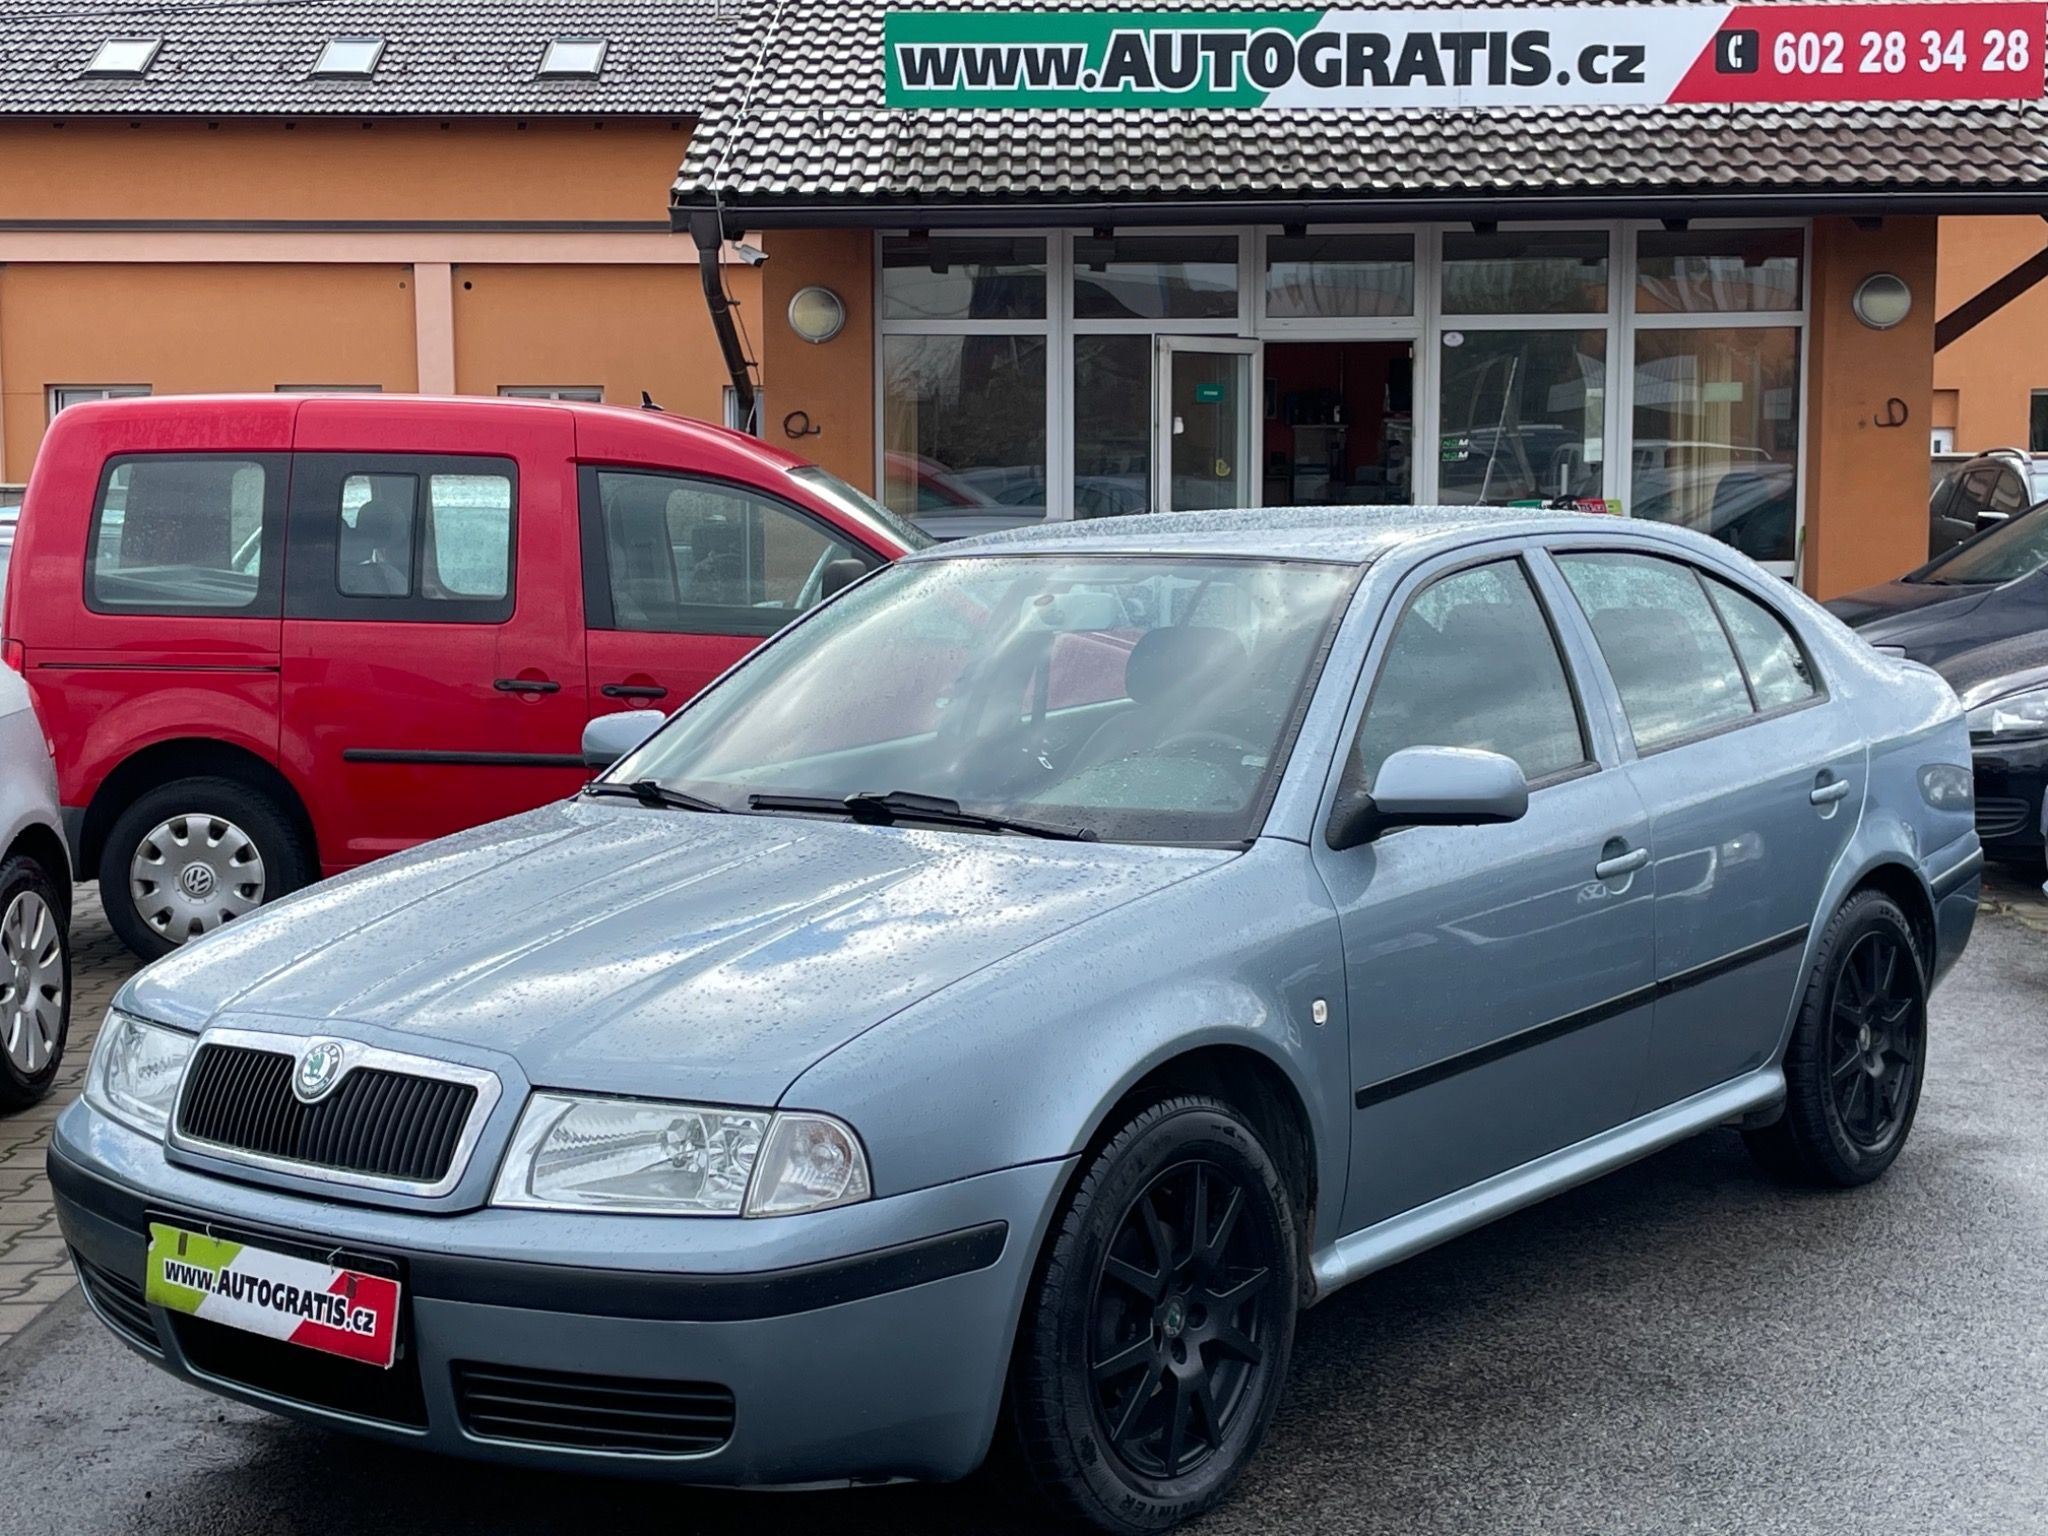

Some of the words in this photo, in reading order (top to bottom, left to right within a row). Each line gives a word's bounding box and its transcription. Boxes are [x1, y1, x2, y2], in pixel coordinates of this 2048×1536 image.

[900, 31, 1646, 88] www.AUTOGRATIS.cz
[1773, 31, 1844, 75] 602
[1859, 31, 1906, 74] 28
[1919, 30, 1967, 73] 34
[1981, 29, 2030, 72] 28
[164, 1260, 375, 1333] www.AUTOGRATIS.cz
